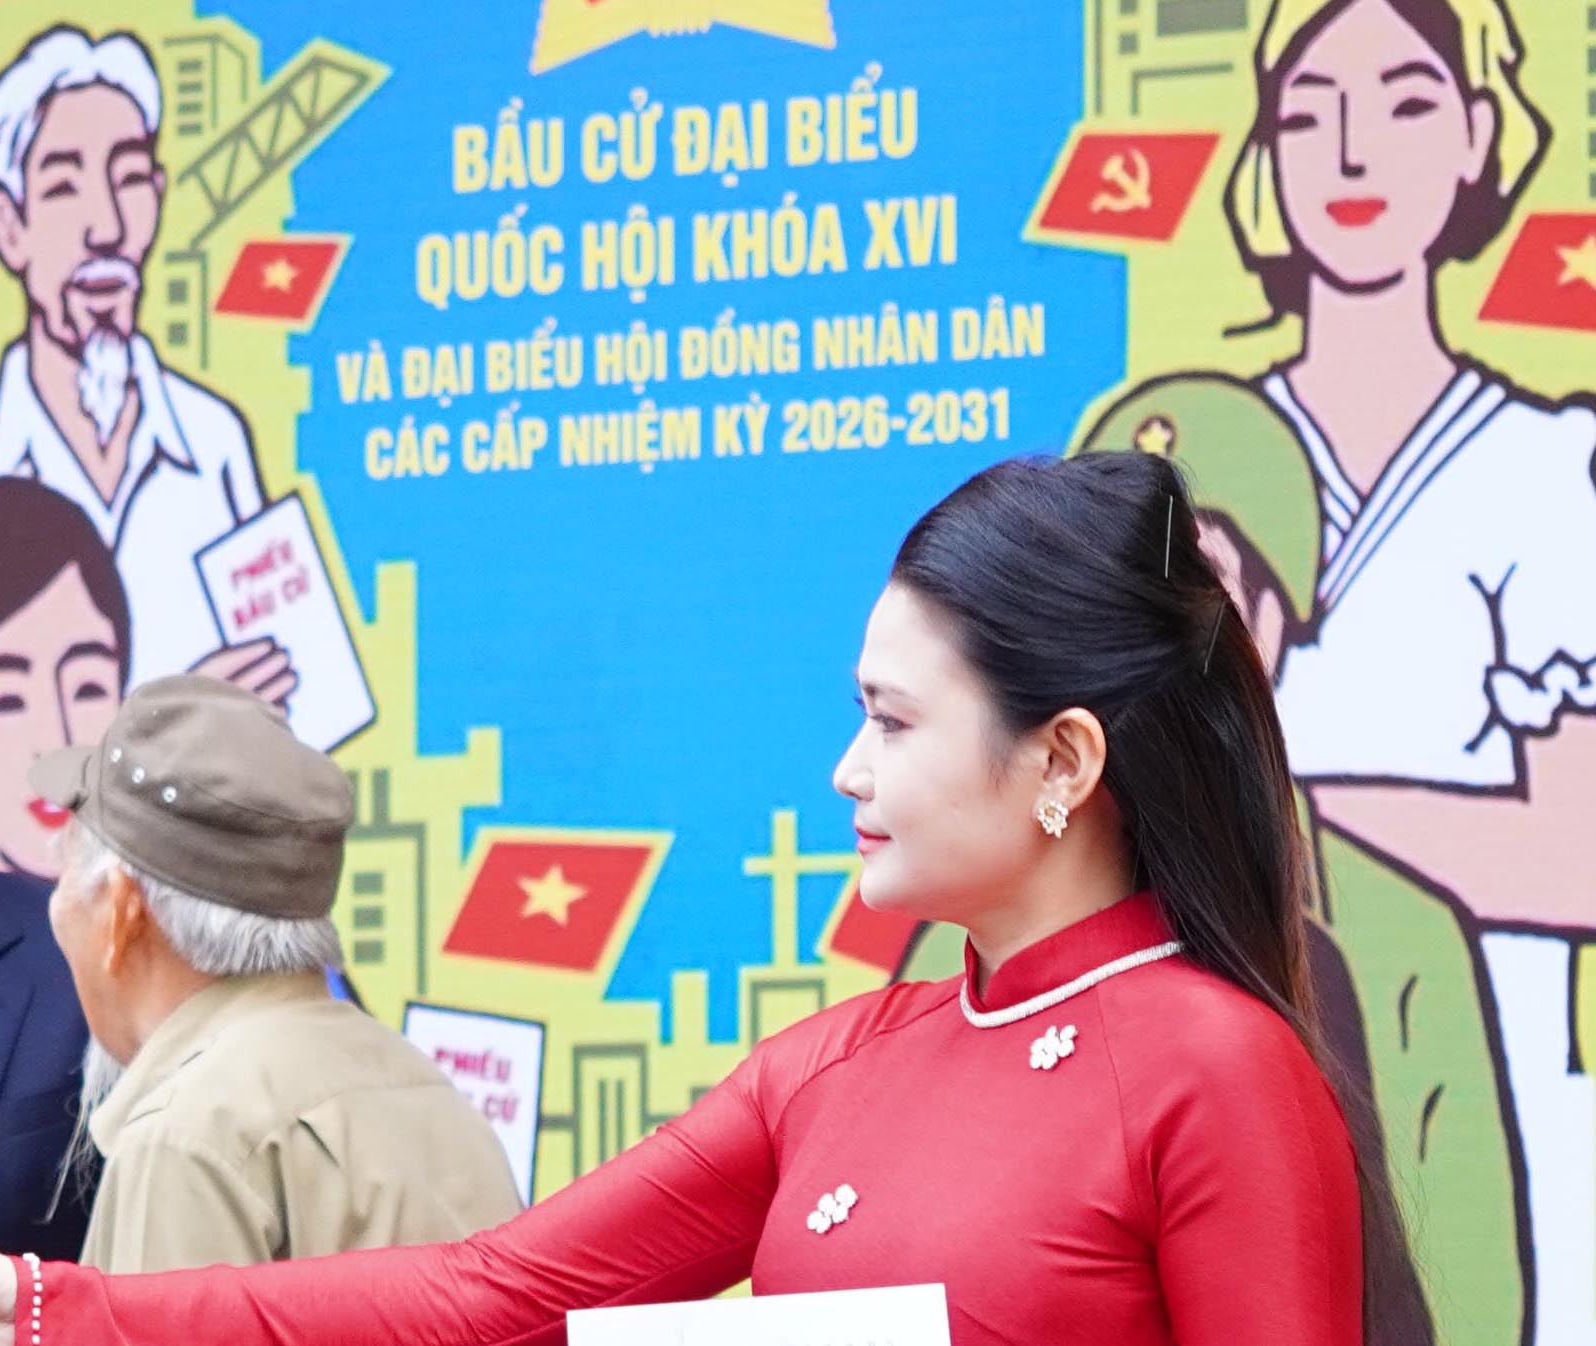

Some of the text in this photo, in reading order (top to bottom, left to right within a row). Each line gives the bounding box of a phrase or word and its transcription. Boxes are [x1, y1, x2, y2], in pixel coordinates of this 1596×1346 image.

[453, 63, 918, 194] BẦU CỬ ĐẠI BIỂU
[416, 192, 957, 310] QUỐC HỘI KHÓA XVI
[336, 334, 392, 404] VÀ
[402, 344, 474, 408] ĐẠI
[485, 318, 583, 393] BIỂU
[594, 321, 667, 394] HỘI
[813, 303, 938, 370] NHÂN
[951, 296, 1045, 361] DÂN
[365, 389, 1010, 480] CÁC CẤP NHIỆM KỲ 2026-2031
